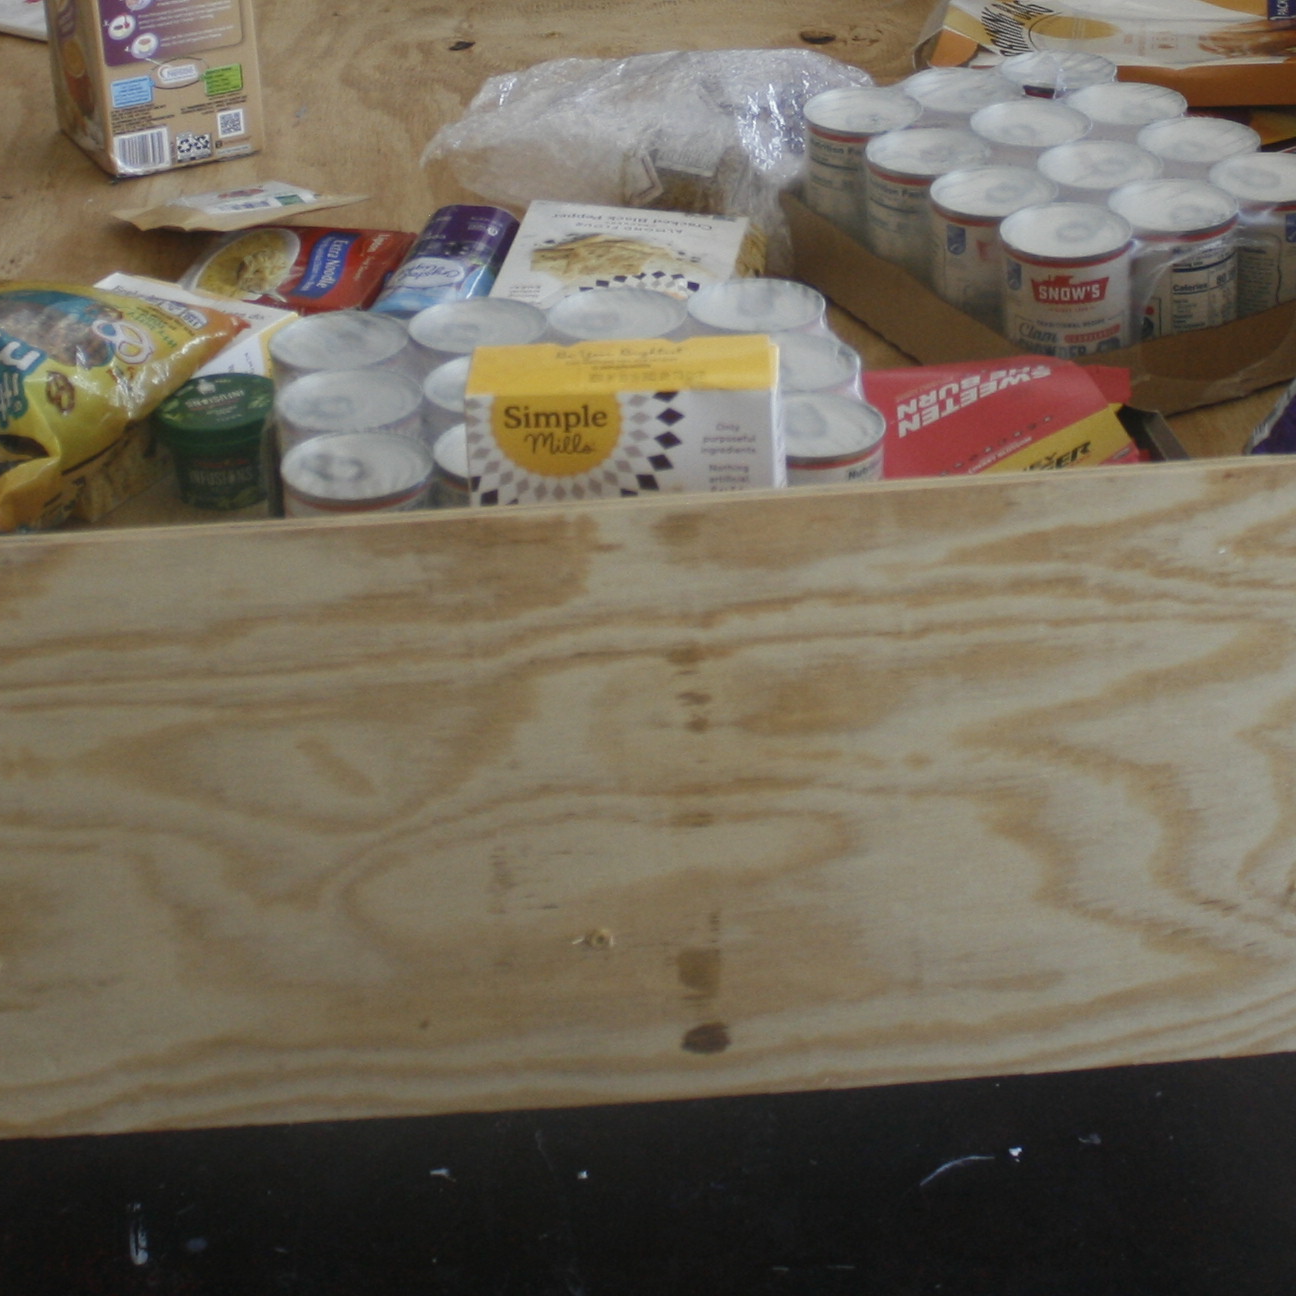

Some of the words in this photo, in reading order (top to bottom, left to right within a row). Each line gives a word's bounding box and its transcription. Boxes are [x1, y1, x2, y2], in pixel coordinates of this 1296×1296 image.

[551, 212, 602, 221] Pepper
[608, 215, 649, 224] Black
[654, 219, 713, 232] Cracked
[328, 239, 350, 264] Extra
[319, 259, 342, 289] Noodle
[1038, 284, 1101, 302] SNOW'S
[1019, 322, 1058, 343] Clam
[896, 374, 982, 421] BURN
[898, 365, 1052, 439] SWEETEN
[504, 404, 608, 433] Simple
[716, 424, 740, 432] Only
[523, 431, 594, 455] Mills
[702, 434, 756, 444] purposeful
[700, 446, 756, 455] ingredients
[709, 464, 750, 473] Nothing
